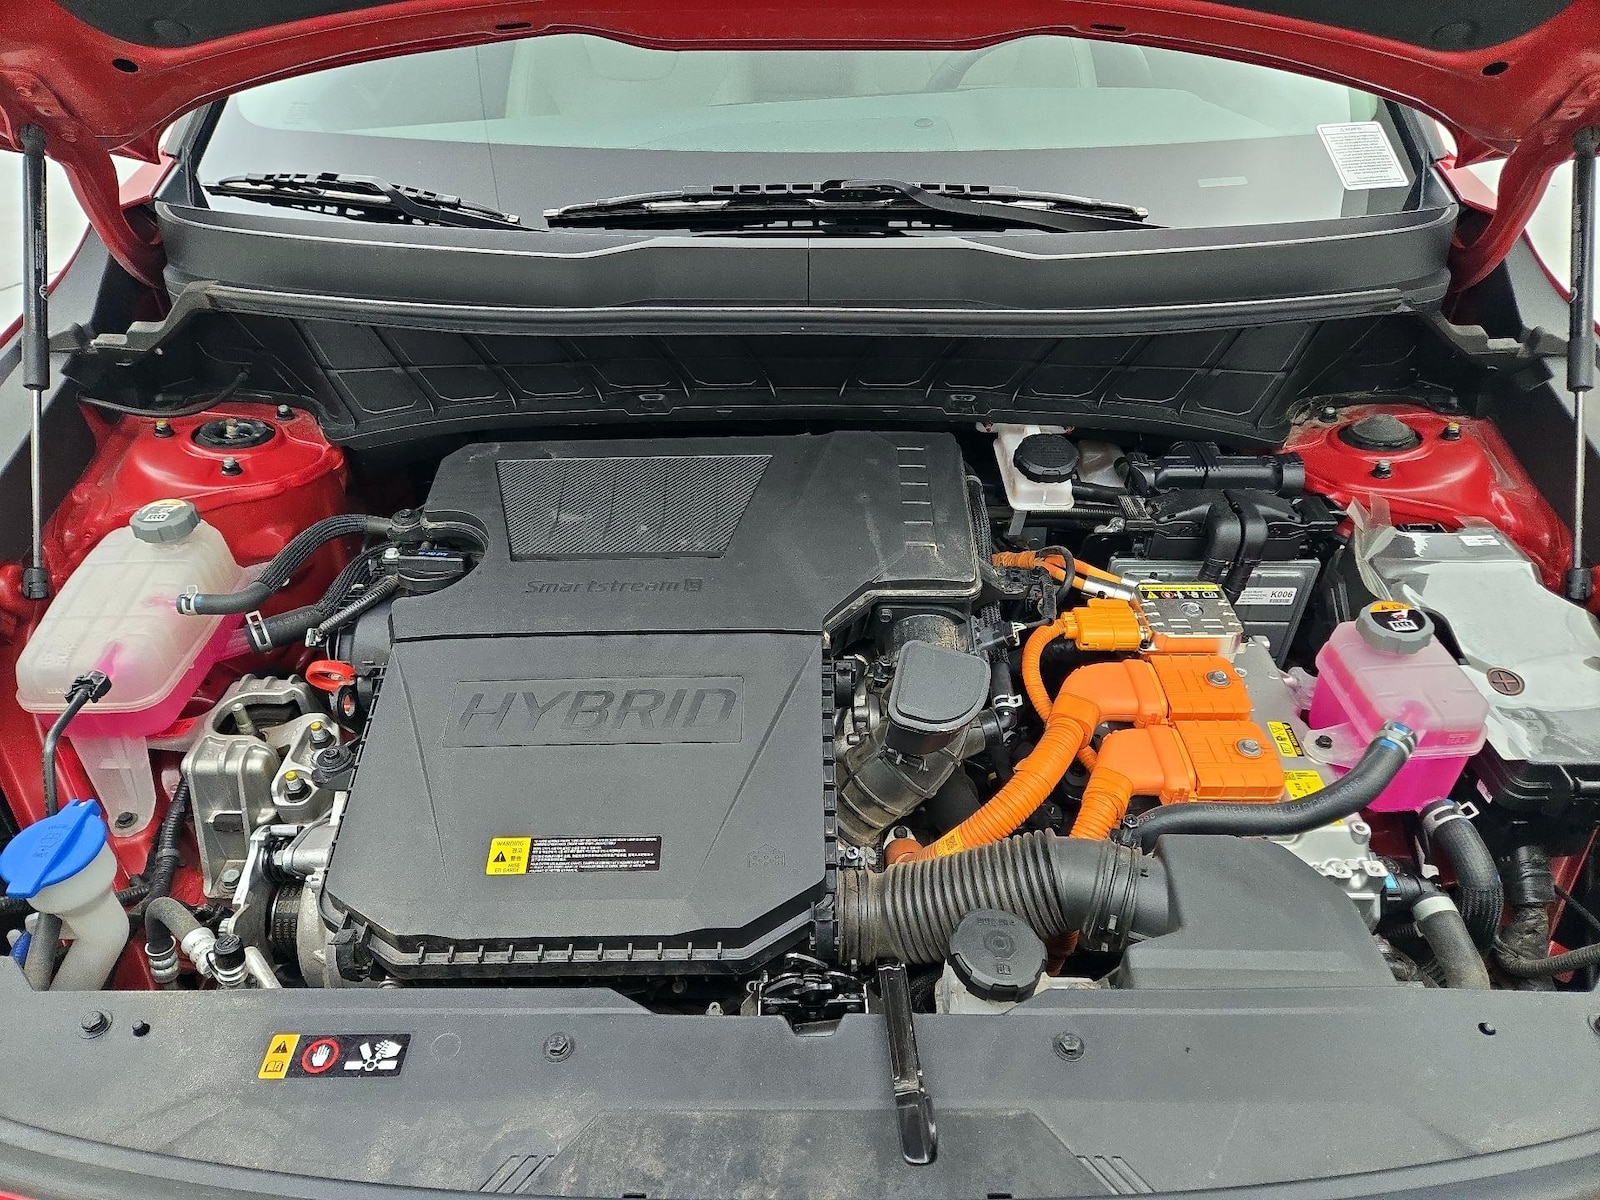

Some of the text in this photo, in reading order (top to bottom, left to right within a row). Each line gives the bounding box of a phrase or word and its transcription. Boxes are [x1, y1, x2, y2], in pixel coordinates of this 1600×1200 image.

[525, 580, 680, 593] Smartstream
[1270, 590, 1294, 598] K006
[457, 688, 737, 732] HYBRID
